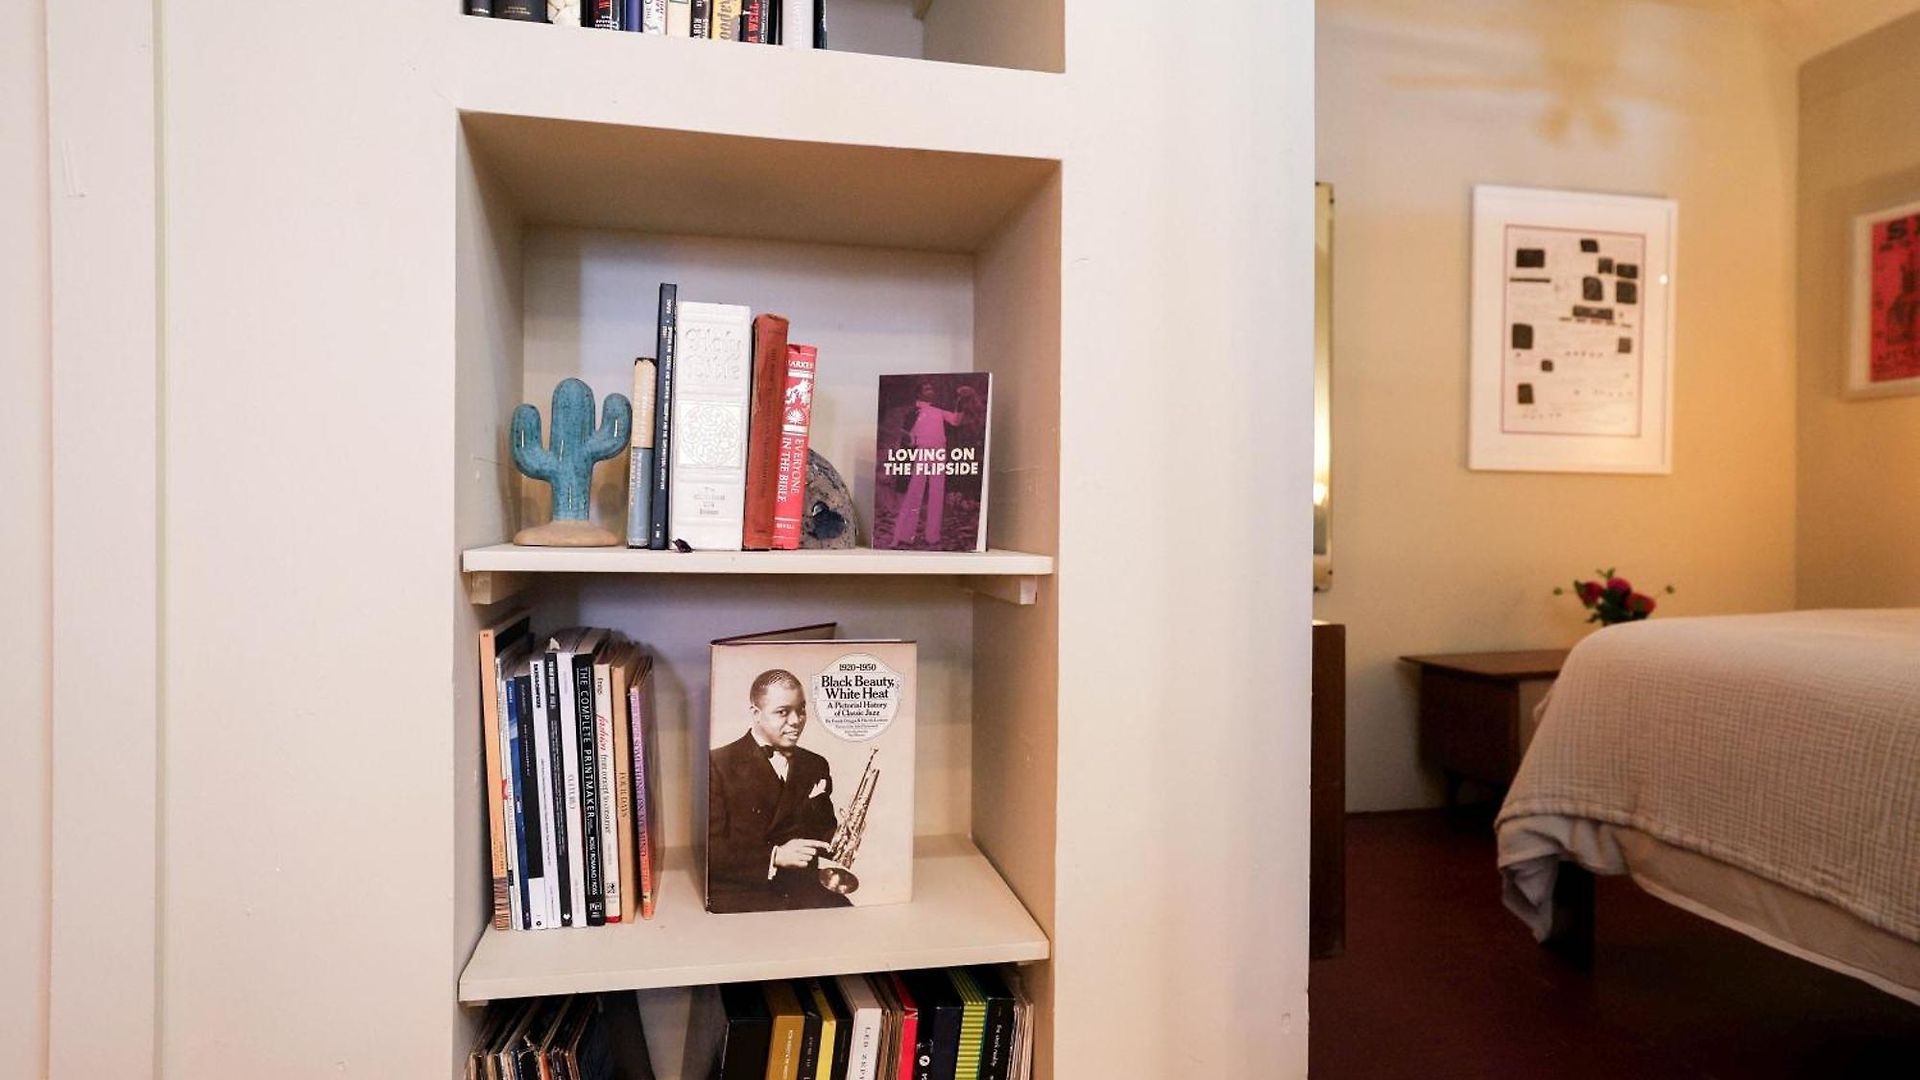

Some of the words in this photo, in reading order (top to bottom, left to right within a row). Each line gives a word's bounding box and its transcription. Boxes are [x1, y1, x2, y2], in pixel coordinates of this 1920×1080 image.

[782, 436, 792, 449] IN
[780, 451, 791, 472] THE
[888, 449, 946, 462] LOVING
[951, 448, 975, 461] ON
[790, 438, 805, 496] EVERYONE
[884, 463, 911, 476] THE
[915, 462, 978, 476] FLIPSIDE
[776, 474, 789, 504] BIBLE
[839, 663, 877, 672] 1920-1950
[579, 667, 588, 686] THE
[821, 675, 852, 688] Black
[854, 675, 895, 689] Beauty,
[825, 687, 861, 699] White
[862, 687, 889, 699] Heat
[835, 701, 862, 709] Pictorial
[863, 701, 887, 710] History
[580, 690, 591, 743] COMPLETE
[595, 712, 609, 751] fashion
[863, 1026, 871, 1048] LED
